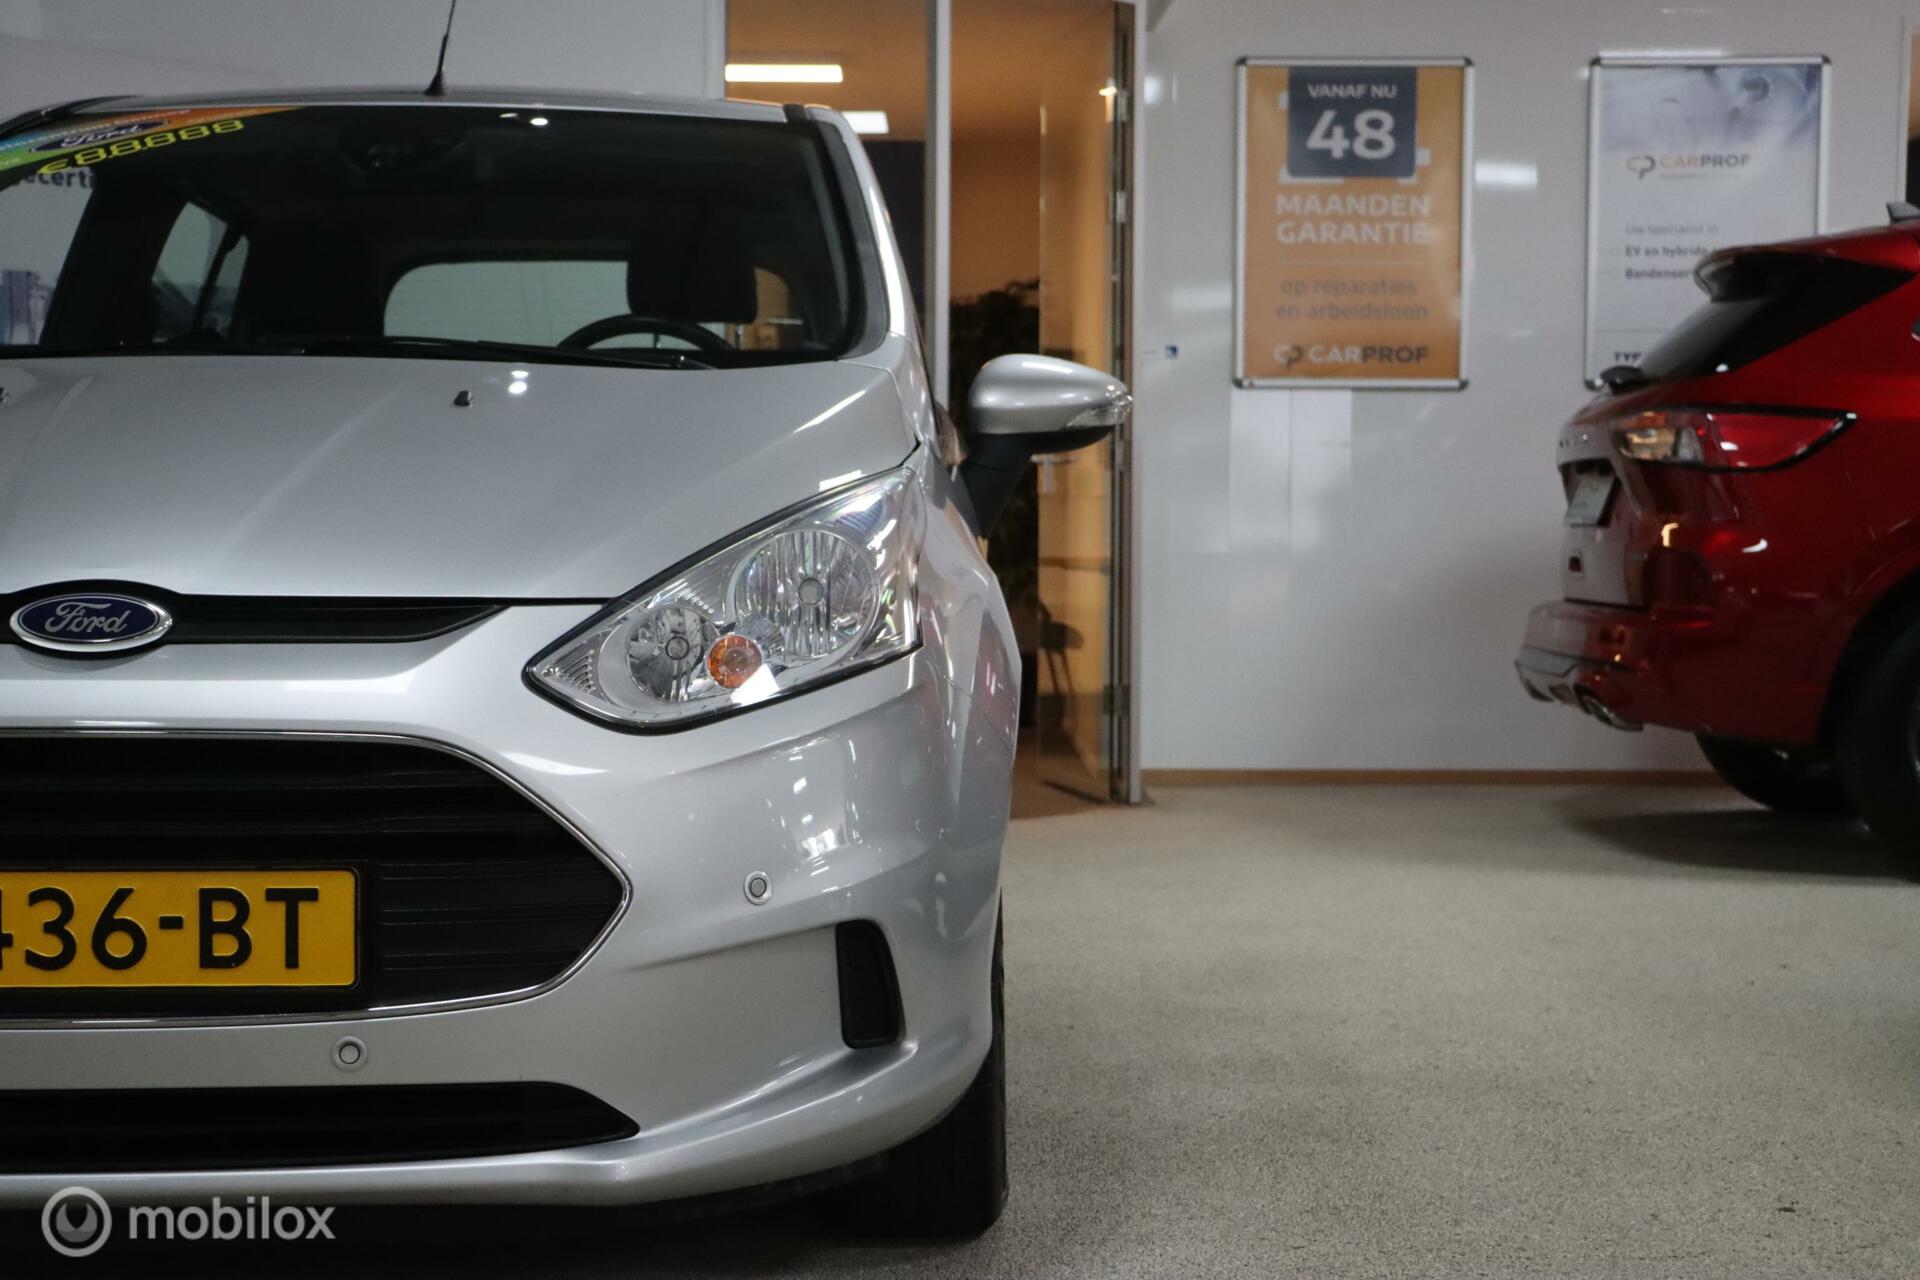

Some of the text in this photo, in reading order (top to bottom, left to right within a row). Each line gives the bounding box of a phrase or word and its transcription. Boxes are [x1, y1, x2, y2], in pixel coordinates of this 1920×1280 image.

[1307, 84, 1397, 98] VANAF NU
[1305, 109, 1396, 159] 48
[1659, 153, 1751, 169] CARPROF
[1276, 195, 1431, 216] MAANDEN
[1275, 222, 1432, 245] GARANTIE
[1625, 267, 1695, 280] Bandenser
[1280, 278, 1417, 298] op reparaties
[1276, 303, 1429, 320] en arbeidsloon
[1308, 346, 1429, 364] CARPROF
[44, 603, 128, 635] Ford
[0, 886, 319, 971] 36-BT
